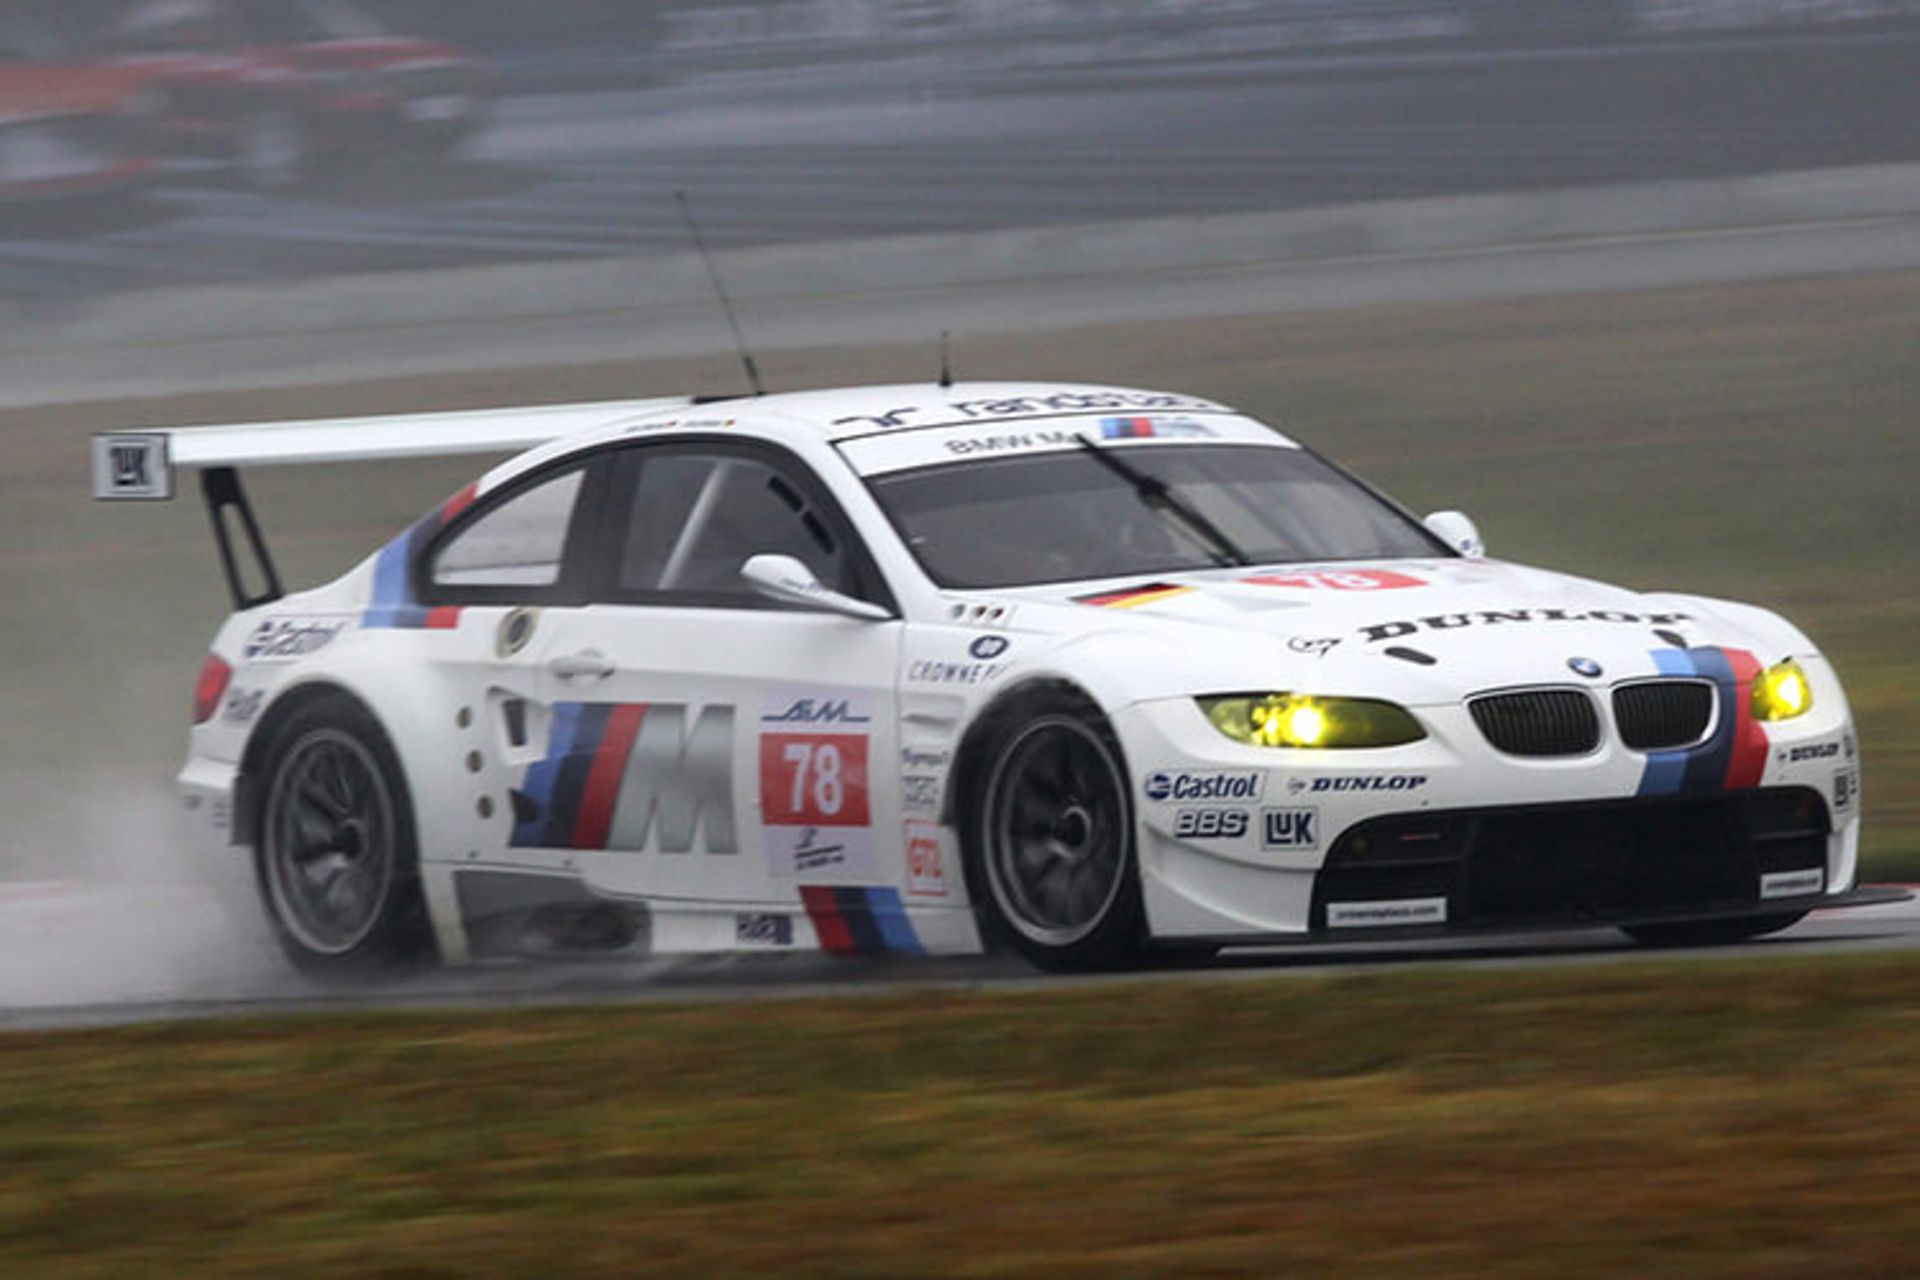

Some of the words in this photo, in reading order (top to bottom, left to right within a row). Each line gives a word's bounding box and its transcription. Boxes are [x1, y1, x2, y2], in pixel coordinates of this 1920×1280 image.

[1358, 609, 1694, 643] DUNLOP
[784, 743, 844, 815] 78
[1172, 774, 1258, 799] Castrol
[1310, 775, 1428, 792] DUNLOP
[1175, 810, 1250, 838] BBS
